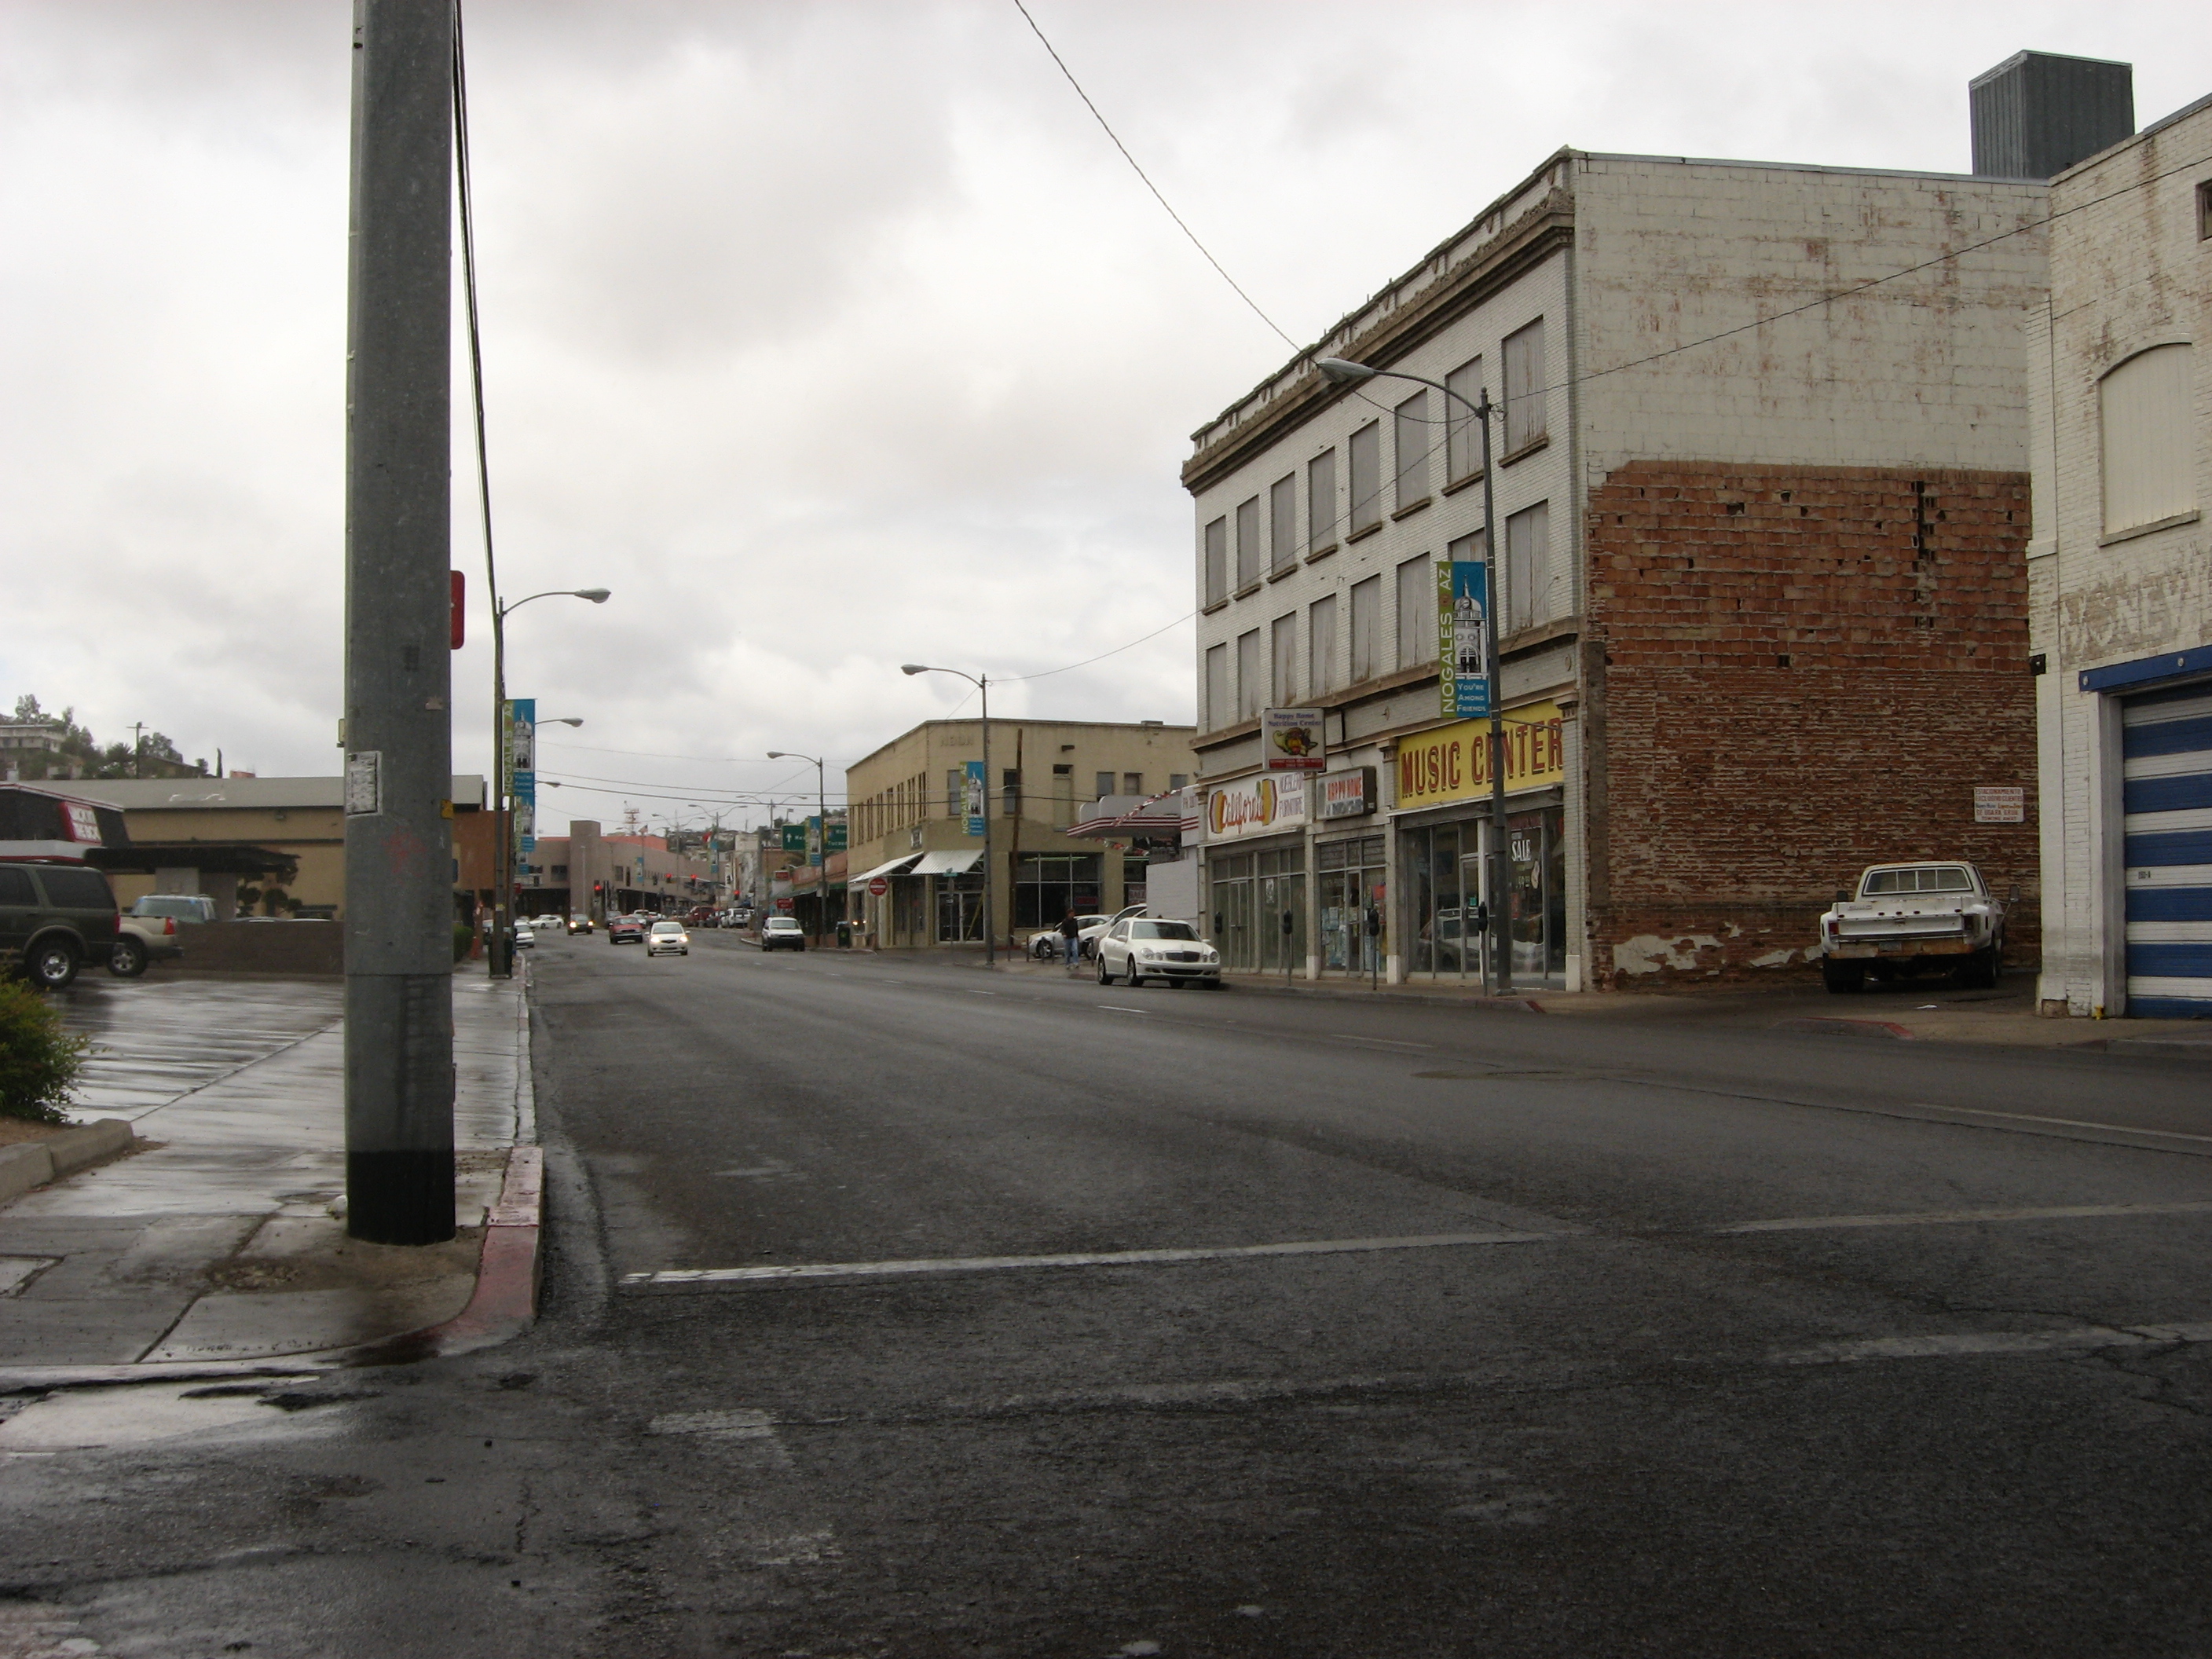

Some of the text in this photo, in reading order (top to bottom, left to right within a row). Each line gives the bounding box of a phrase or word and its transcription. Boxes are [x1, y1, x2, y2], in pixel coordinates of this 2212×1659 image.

[1439, 568, 1455, 712] NOGALES AZ
[504, 703, 513, 793] NOGALES AZ
[1401, 741, 1460, 799] MUSIC
[960, 786, 969, 833] NOGALES
[1220, 790, 1265, 834] California
[1511, 839, 1531, 862] SALE
